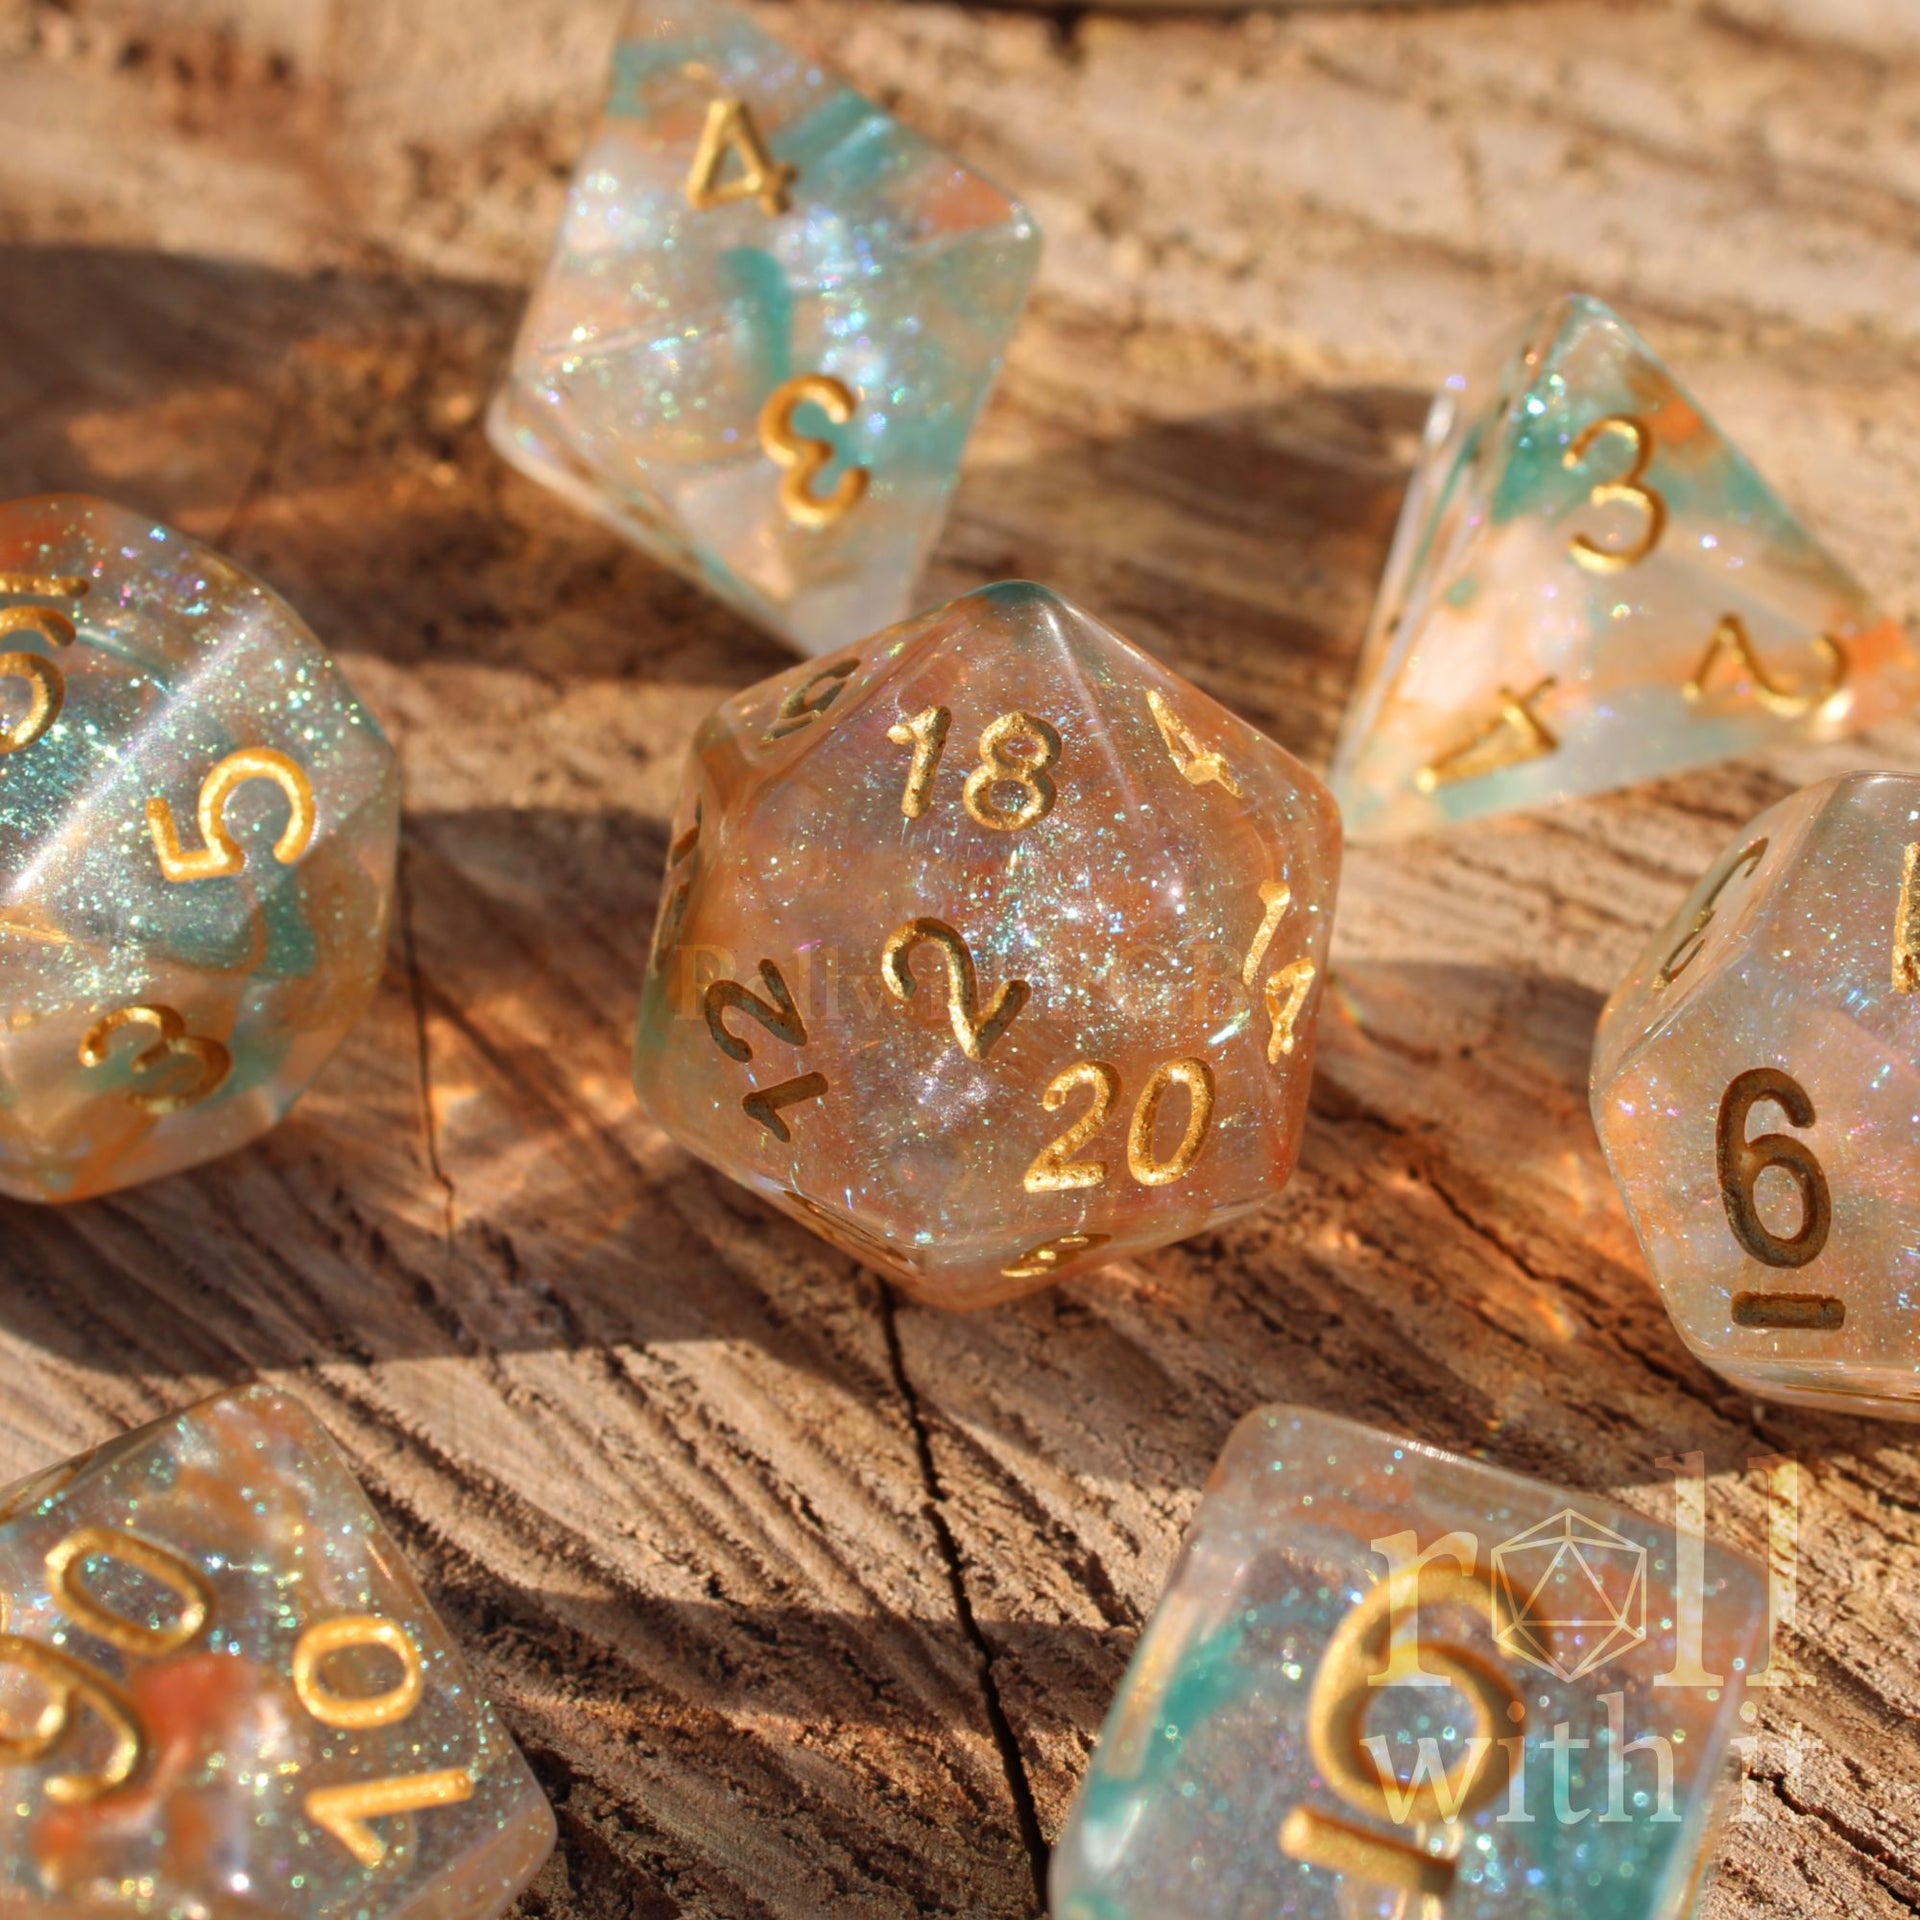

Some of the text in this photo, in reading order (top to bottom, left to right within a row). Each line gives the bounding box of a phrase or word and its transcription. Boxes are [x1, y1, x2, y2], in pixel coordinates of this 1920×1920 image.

[688, 99, 796, 216] 4
[760, 373, 870, 529] 3
[1561, 414, 1667, 575] 3
[1416, 676, 1560, 791] 4
[1683, 612, 1853, 724] 2
[146, 746, 318, 882] 5
[887, 705, 1063, 831] 18
[78, 1002, 232, 1112] 3
[704, 958, 829, 1143] 12
[881, 916, 1032, 1061] 2
[1023, 1055, 1217, 1193] 20
[1715, 1067, 1833, 1268] 6
[292, 1615, 475, 1869] 10
[1308, 1556, 1553, 1823] 6
